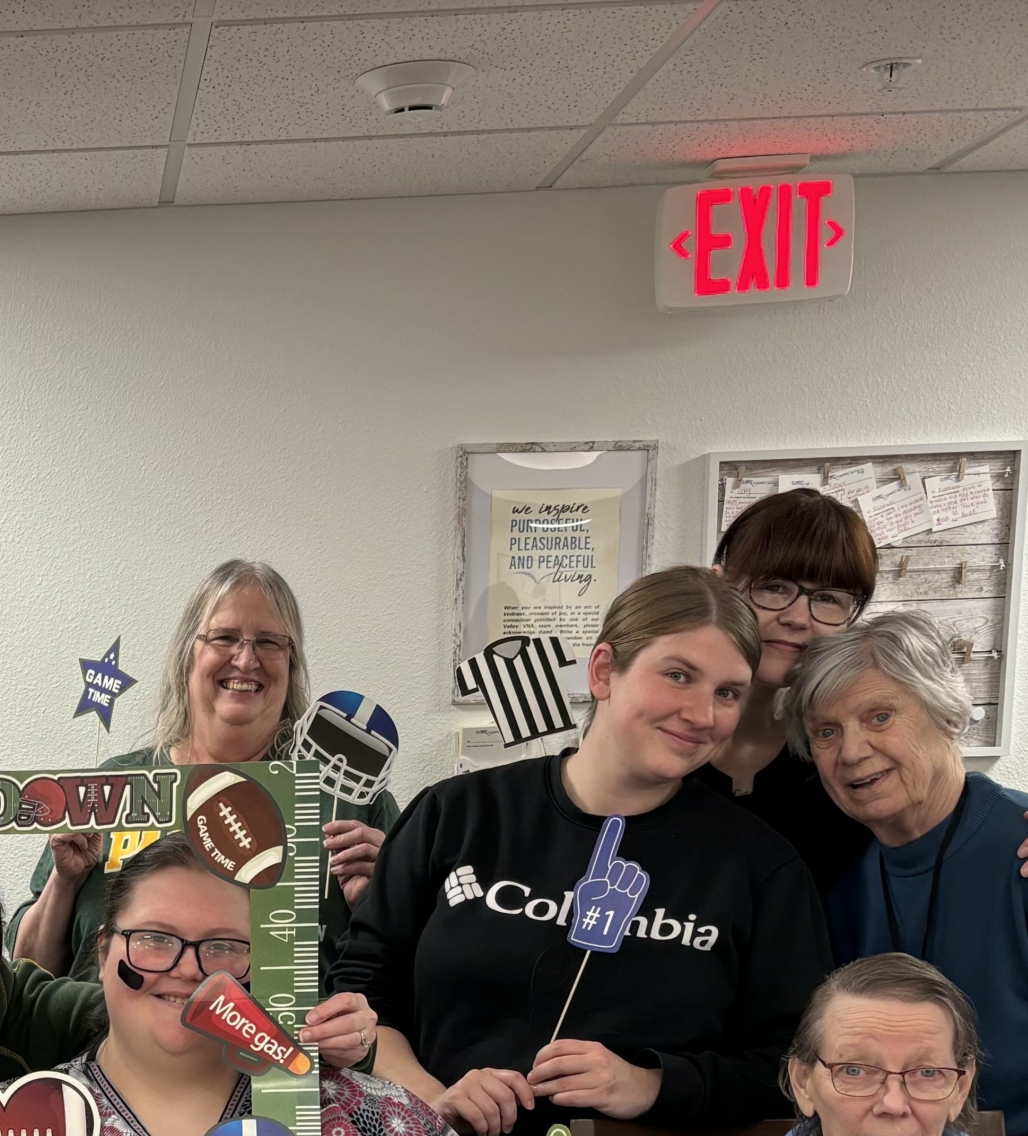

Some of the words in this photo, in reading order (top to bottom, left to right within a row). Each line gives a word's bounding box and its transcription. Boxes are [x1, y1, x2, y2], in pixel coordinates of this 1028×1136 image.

[694, 179, 833, 296] EXIT
[510, 518, 591, 533] PURPOSEFUL,
[512, 505, 532, 514] we
[539, 502, 589, 522] inspire
[509, 536, 595, 552] PLEASURABLE,
[509, 555, 533, 570] AND
[538, 554, 596, 570] PEACEFUL
[552, 560, 597, 597] living.
[85, 669, 122, 693] GAME
[88, 688, 111, 707] TIME
[197, 815, 215, 852] GAME
[211, 845, 236, 872] TIME
[269, 909, 296, 942] 40
[582, 905, 615, 935] #1
[209, 994, 256, 1038] More
[250, 1031, 294, 1064] gas!
